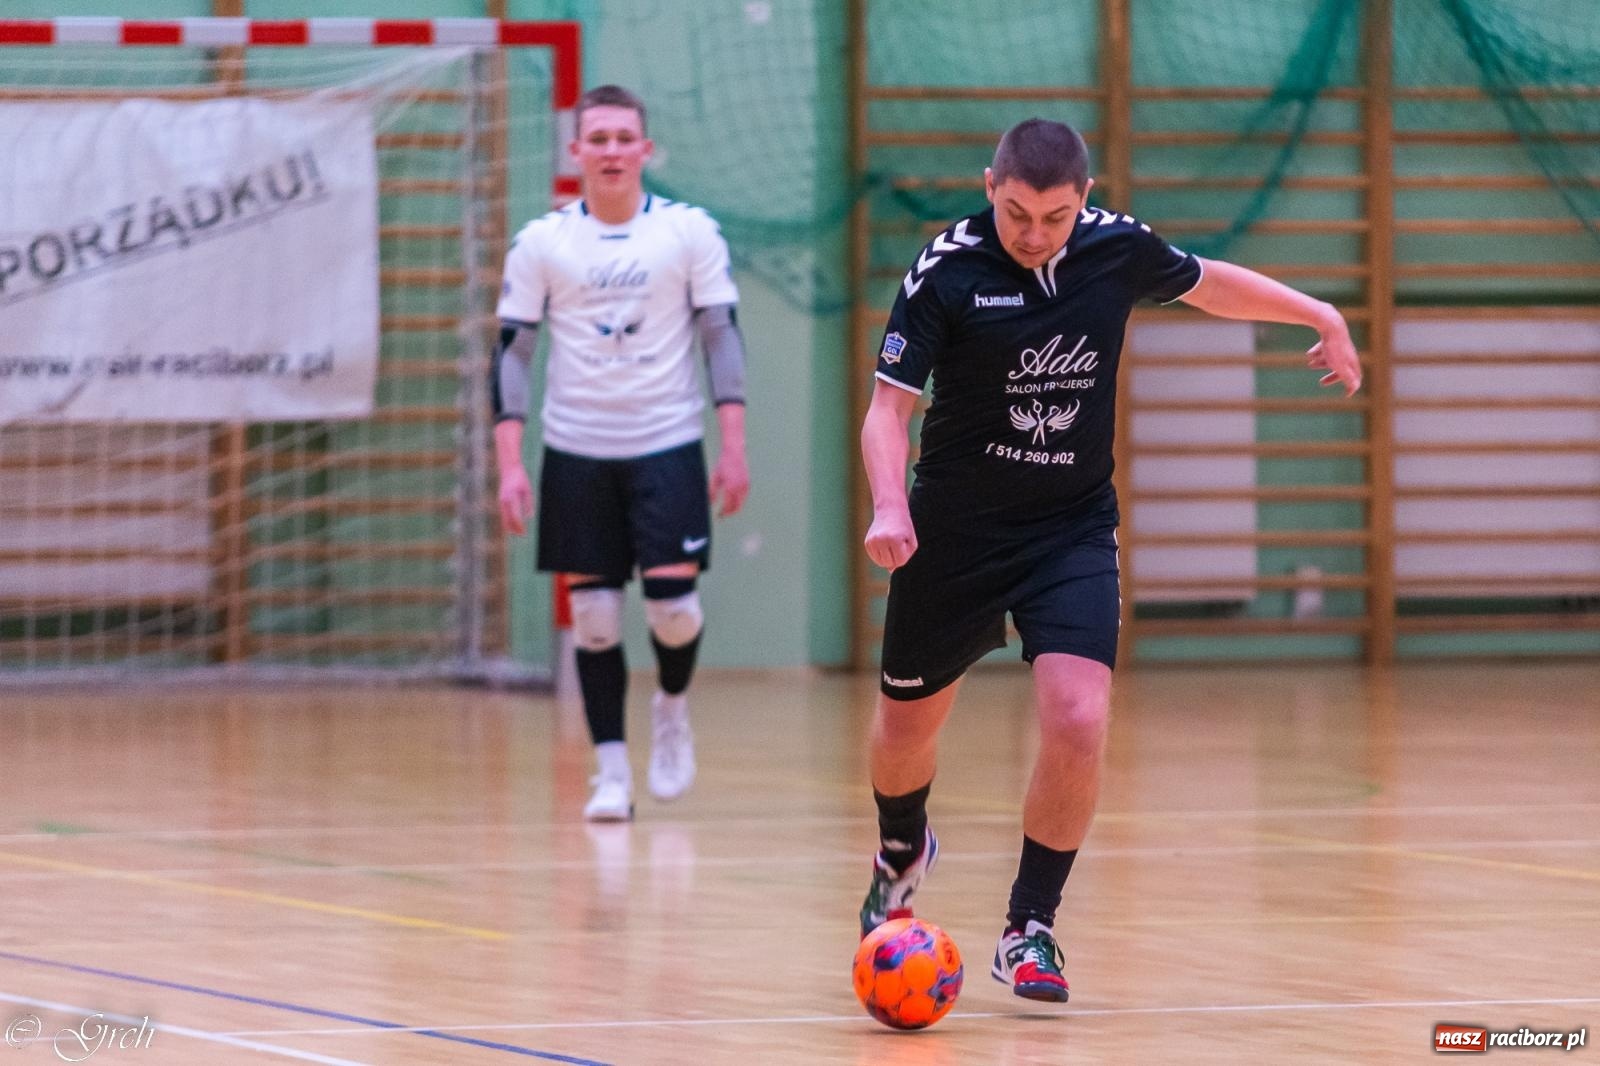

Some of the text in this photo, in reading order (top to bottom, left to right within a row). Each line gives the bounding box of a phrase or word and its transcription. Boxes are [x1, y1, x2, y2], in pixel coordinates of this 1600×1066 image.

[974, 292, 1025, 308] hummel
[1008, 334, 1099, 380] Ada
[1005, 383, 1041, 394] SALON
[996, 444, 1022, 461] 514
[1024, 451, 1050, 465] 260
